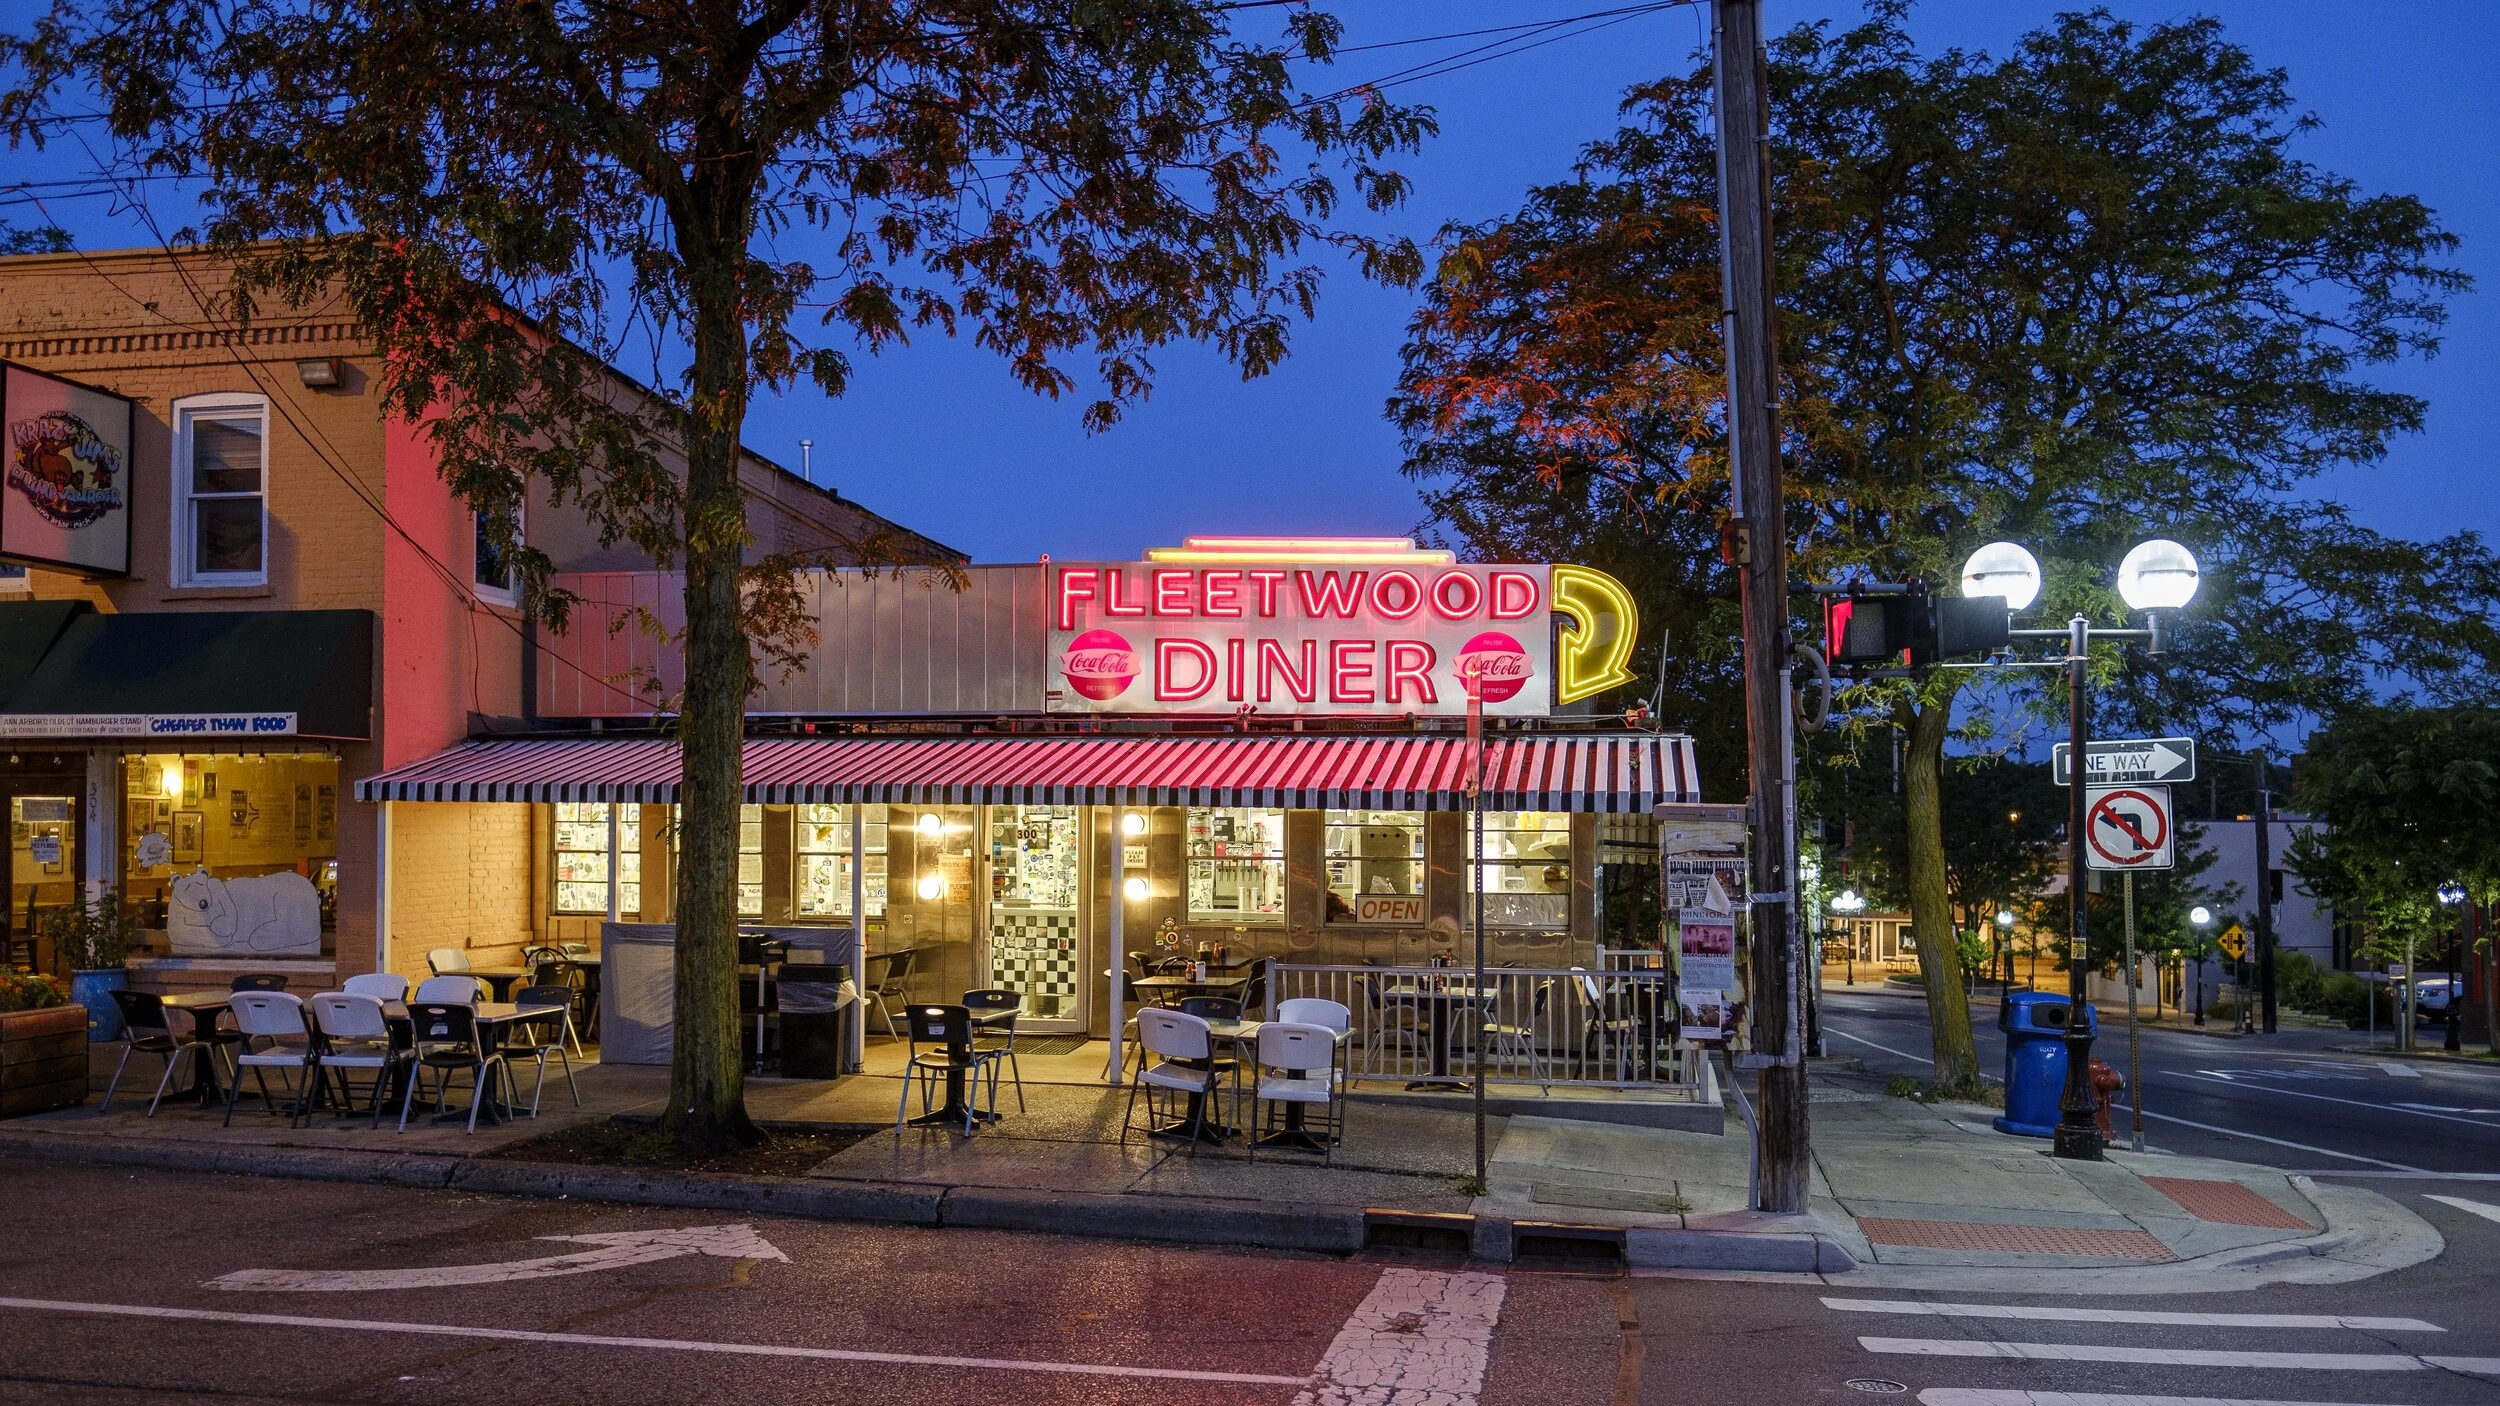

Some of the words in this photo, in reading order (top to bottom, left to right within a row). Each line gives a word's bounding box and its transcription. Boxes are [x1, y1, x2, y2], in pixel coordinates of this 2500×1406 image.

[11, 418, 79, 447] KRAZY
[1058, 568, 1539, 631] FLEETWOOD
[1154, 638, 1438, 703] DINER
[76, 717, 119, 725] HAMBURGER
[120, 717, 142, 725] STAND
[210, 718, 247, 731] THAN
[2113, 754, 2150, 770] WAY
[1017, 830, 1037, 839] 300
[1362, 901, 1419, 920] OPEN
